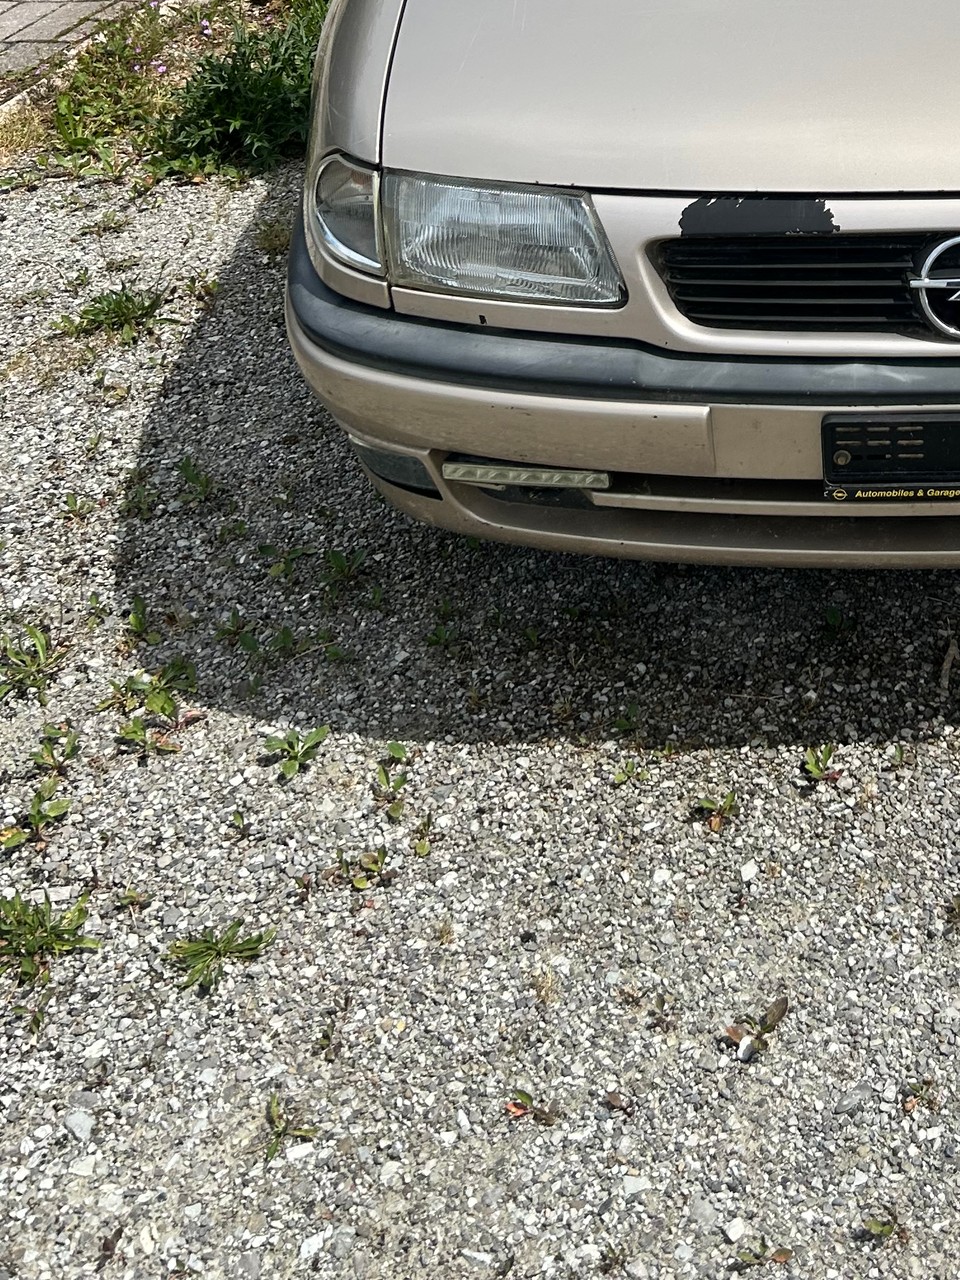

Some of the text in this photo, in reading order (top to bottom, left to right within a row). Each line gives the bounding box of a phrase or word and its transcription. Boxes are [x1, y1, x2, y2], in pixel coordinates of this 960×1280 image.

[855, 489, 915, 498] Automobiles
[916, 489, 924, 497] &
[926, 488, 960, 498] Garage
